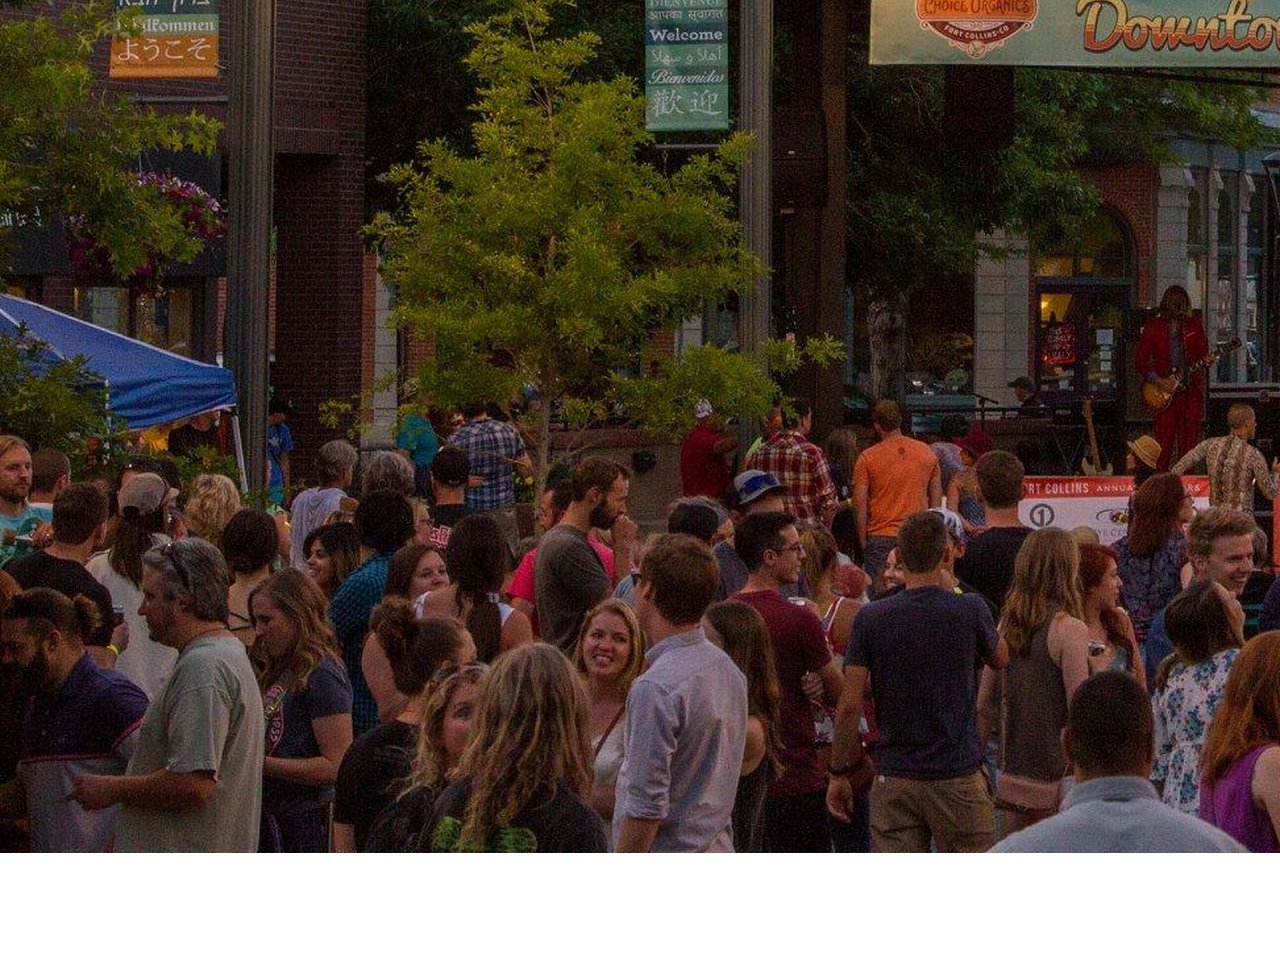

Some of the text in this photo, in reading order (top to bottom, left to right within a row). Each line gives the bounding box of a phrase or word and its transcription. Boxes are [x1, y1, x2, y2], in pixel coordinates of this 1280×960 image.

[649, 27, 723, 42] Welcome
[117, 37, 212, 62] ようこそ
[1045, 482, 1089, 495] COLLINS
[1096, 484, 1136, 493] ANNUA
